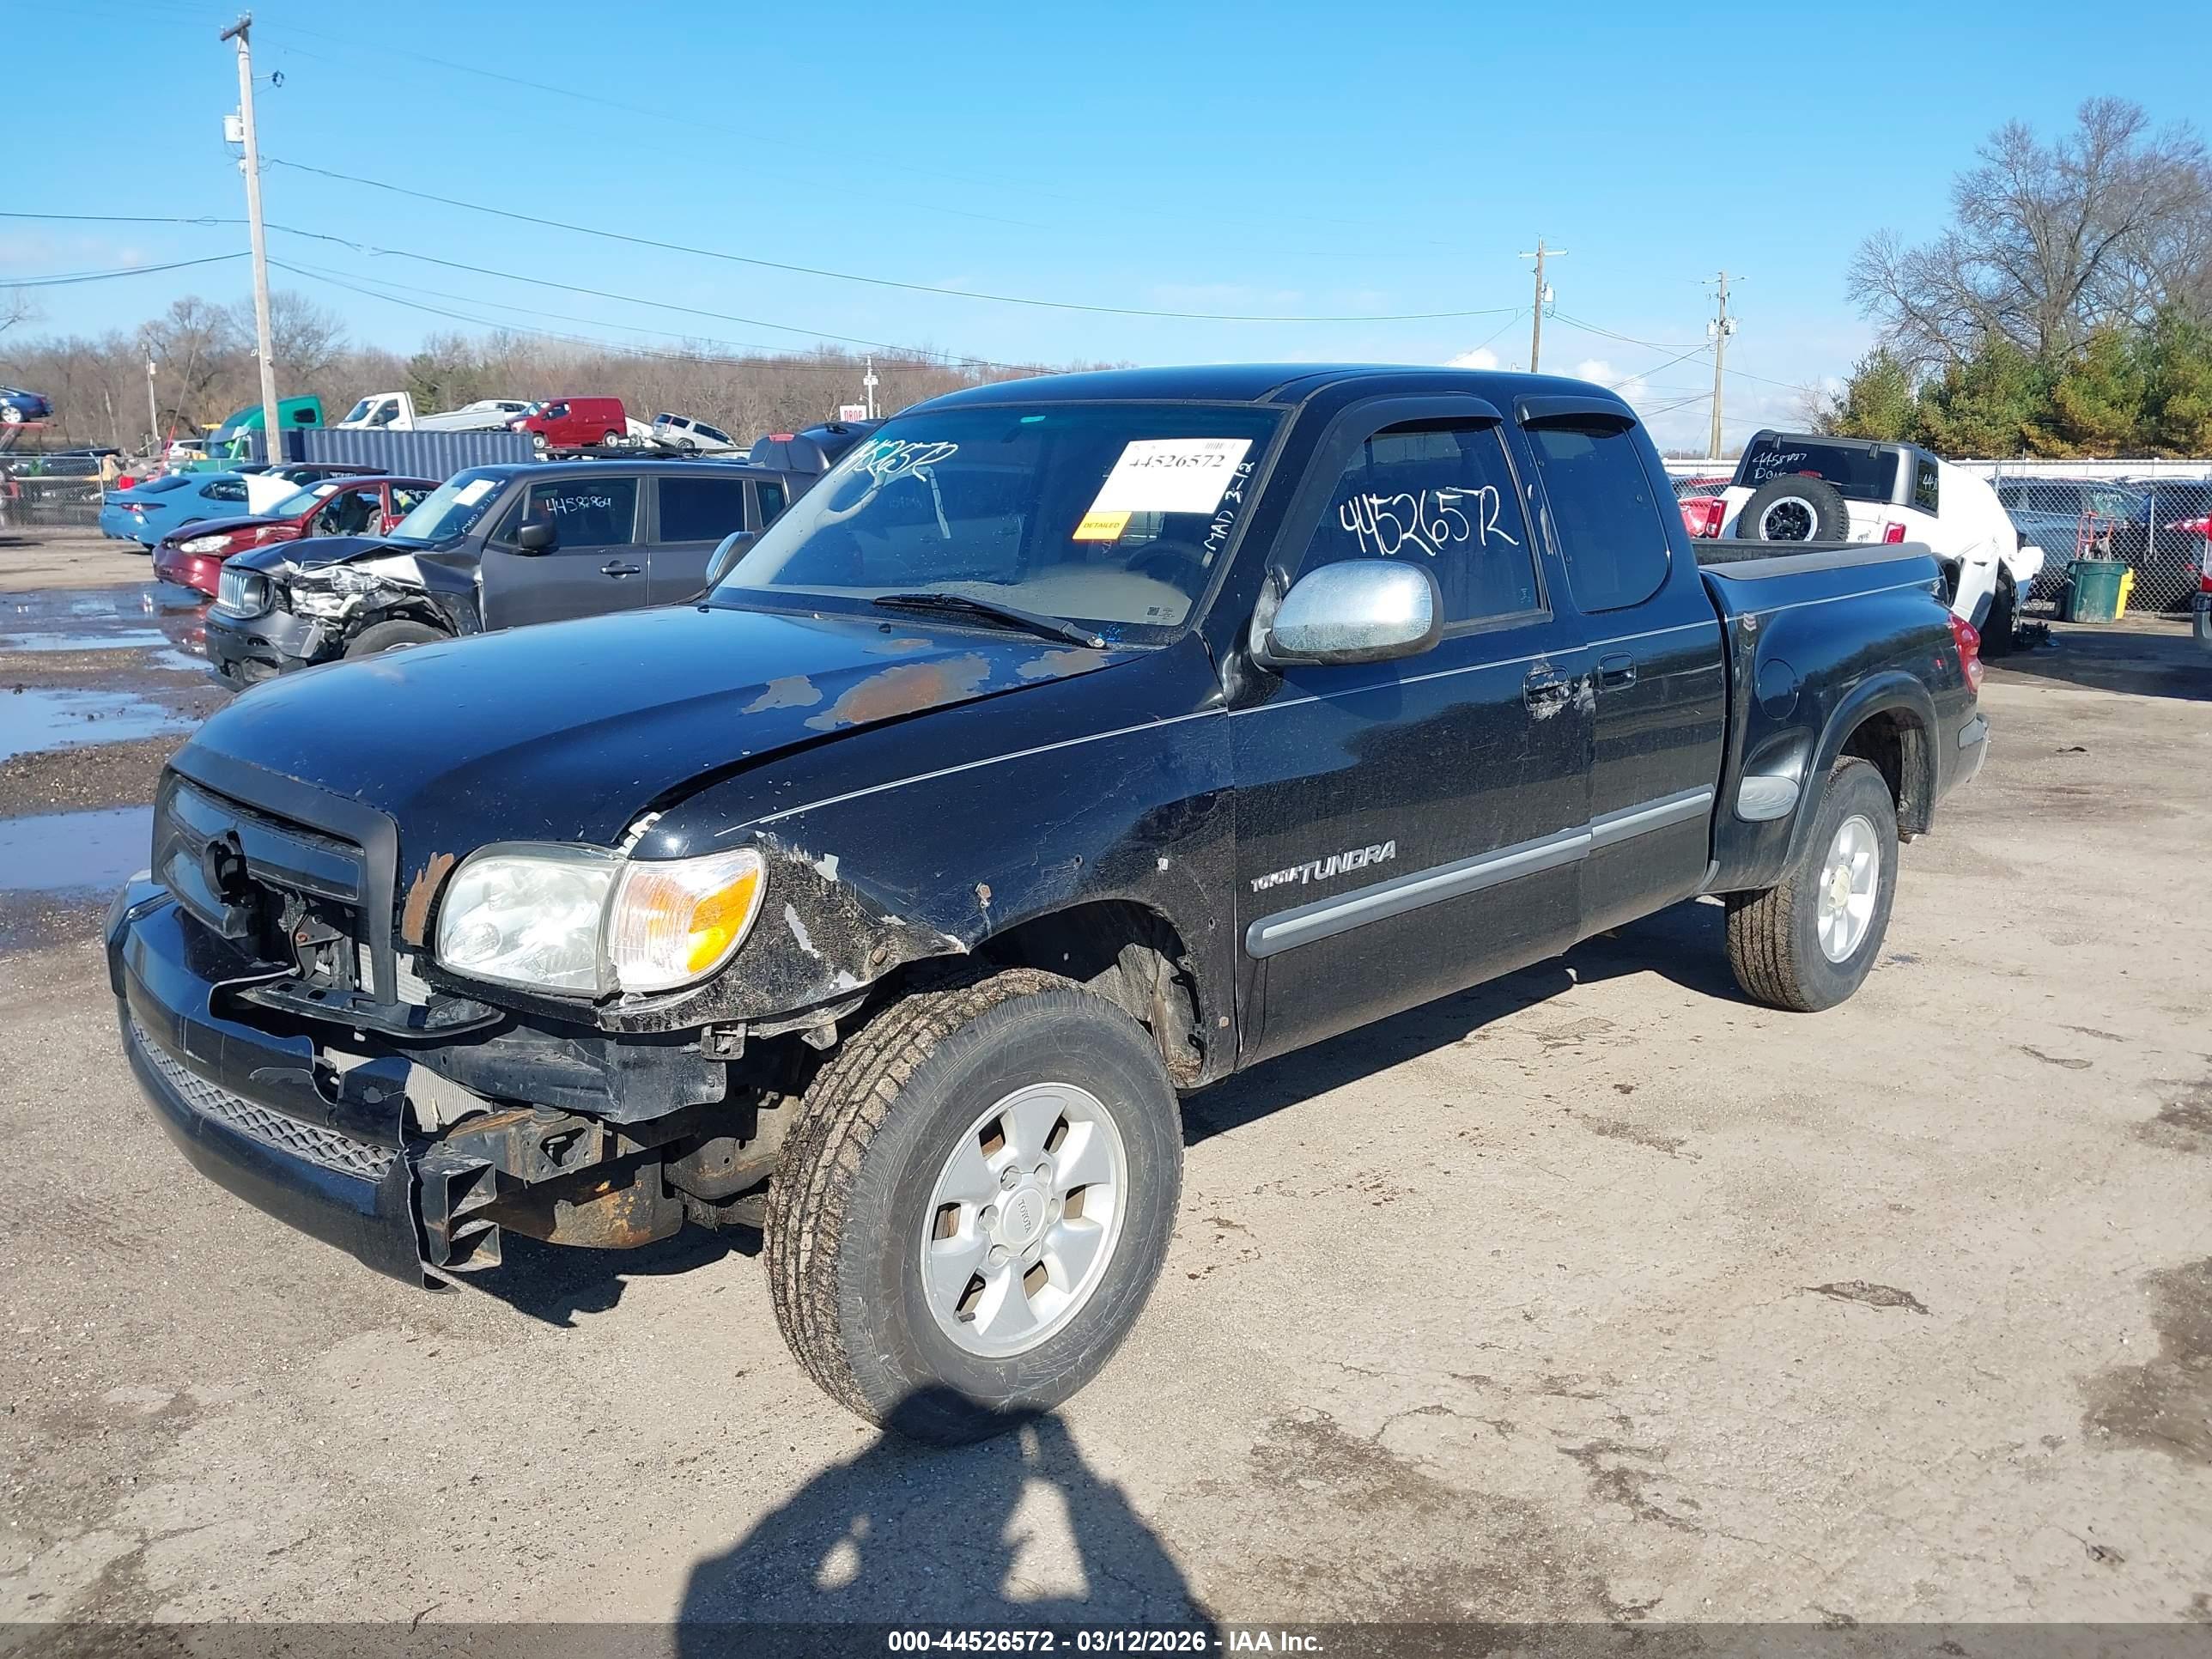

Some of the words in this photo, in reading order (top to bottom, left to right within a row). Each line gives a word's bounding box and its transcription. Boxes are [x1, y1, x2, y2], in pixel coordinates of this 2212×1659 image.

[843, 410, 863, 422] DROP
[1128, 454, 1226, 468] 44526572
[1203, 509, 1235, 552] MAD
[1250, 866, 1301, 893] TOYOTA
[1299, 839, 1396, 885] TUNDRA
[1018, 1199, 1031, 1233] TOYOTA
